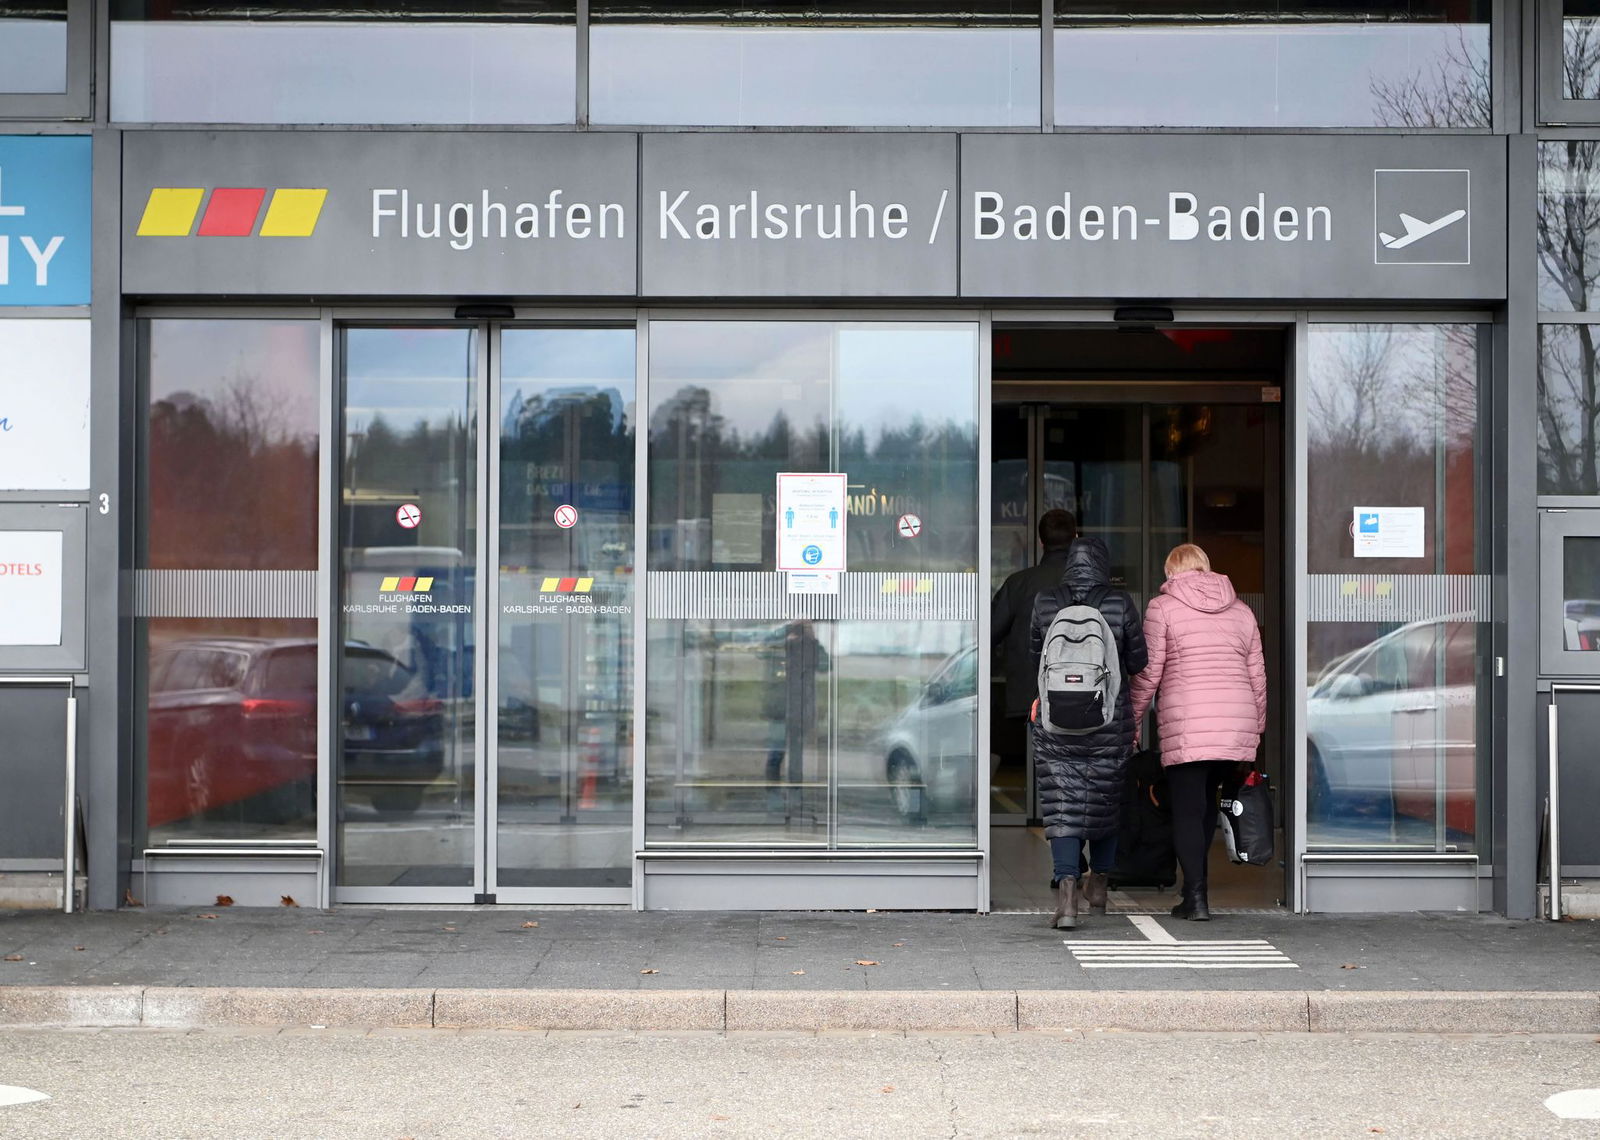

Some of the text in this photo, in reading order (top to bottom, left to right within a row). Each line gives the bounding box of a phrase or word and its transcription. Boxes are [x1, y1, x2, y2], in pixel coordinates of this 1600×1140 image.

[372, 189, 1333, 250] Flughafen Karlsruhe / Baden-Baden
[99, 493, 110, 515] 3
[847, 495, 877, 517] AND
[378, 593, 433, 603] FLUGHAFEN
[538, 594, 593, 604] FLUGHAFEN
[342, 604, 398, 614] KARLSRUHE
[404, 604, 471, 614] BADEN-BADEN
[503, 604, 558, 614] KARLSRUHE
[565, 604, 632, 614] BADEN-BADEN
